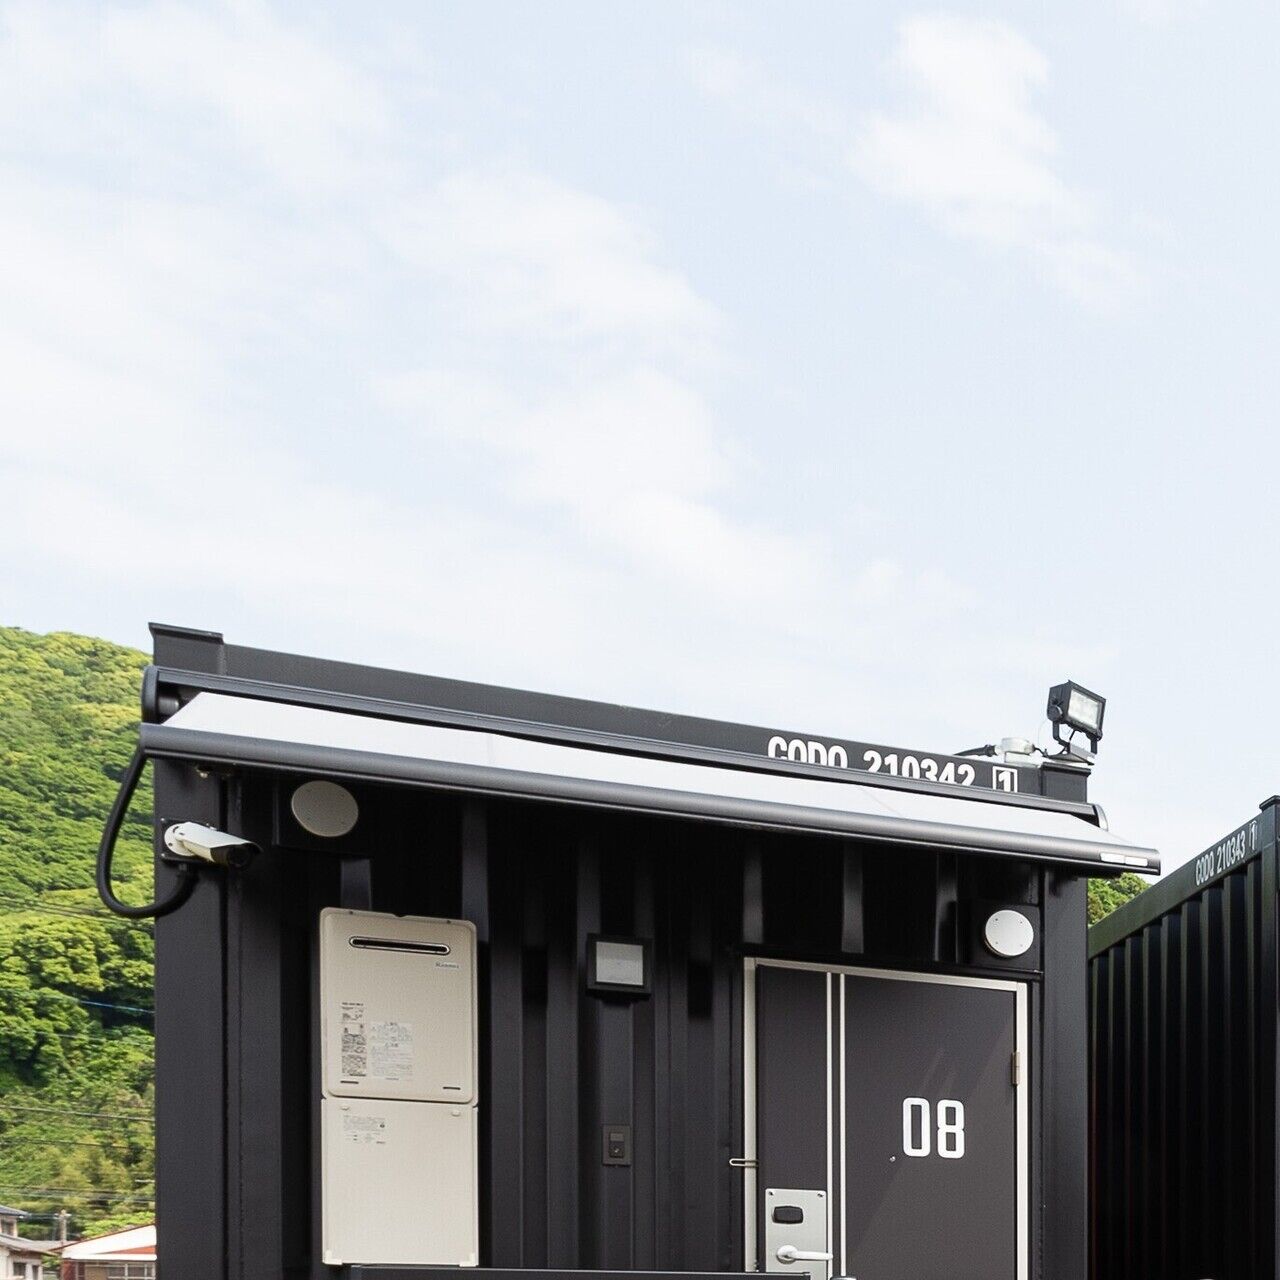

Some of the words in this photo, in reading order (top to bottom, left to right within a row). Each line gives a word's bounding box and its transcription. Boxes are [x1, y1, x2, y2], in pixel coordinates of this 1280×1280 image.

[863, 750, 975, 787] 210342
[1216, 829, 1246, 874] 210343
[903, 1097, 965, 1159] 08
